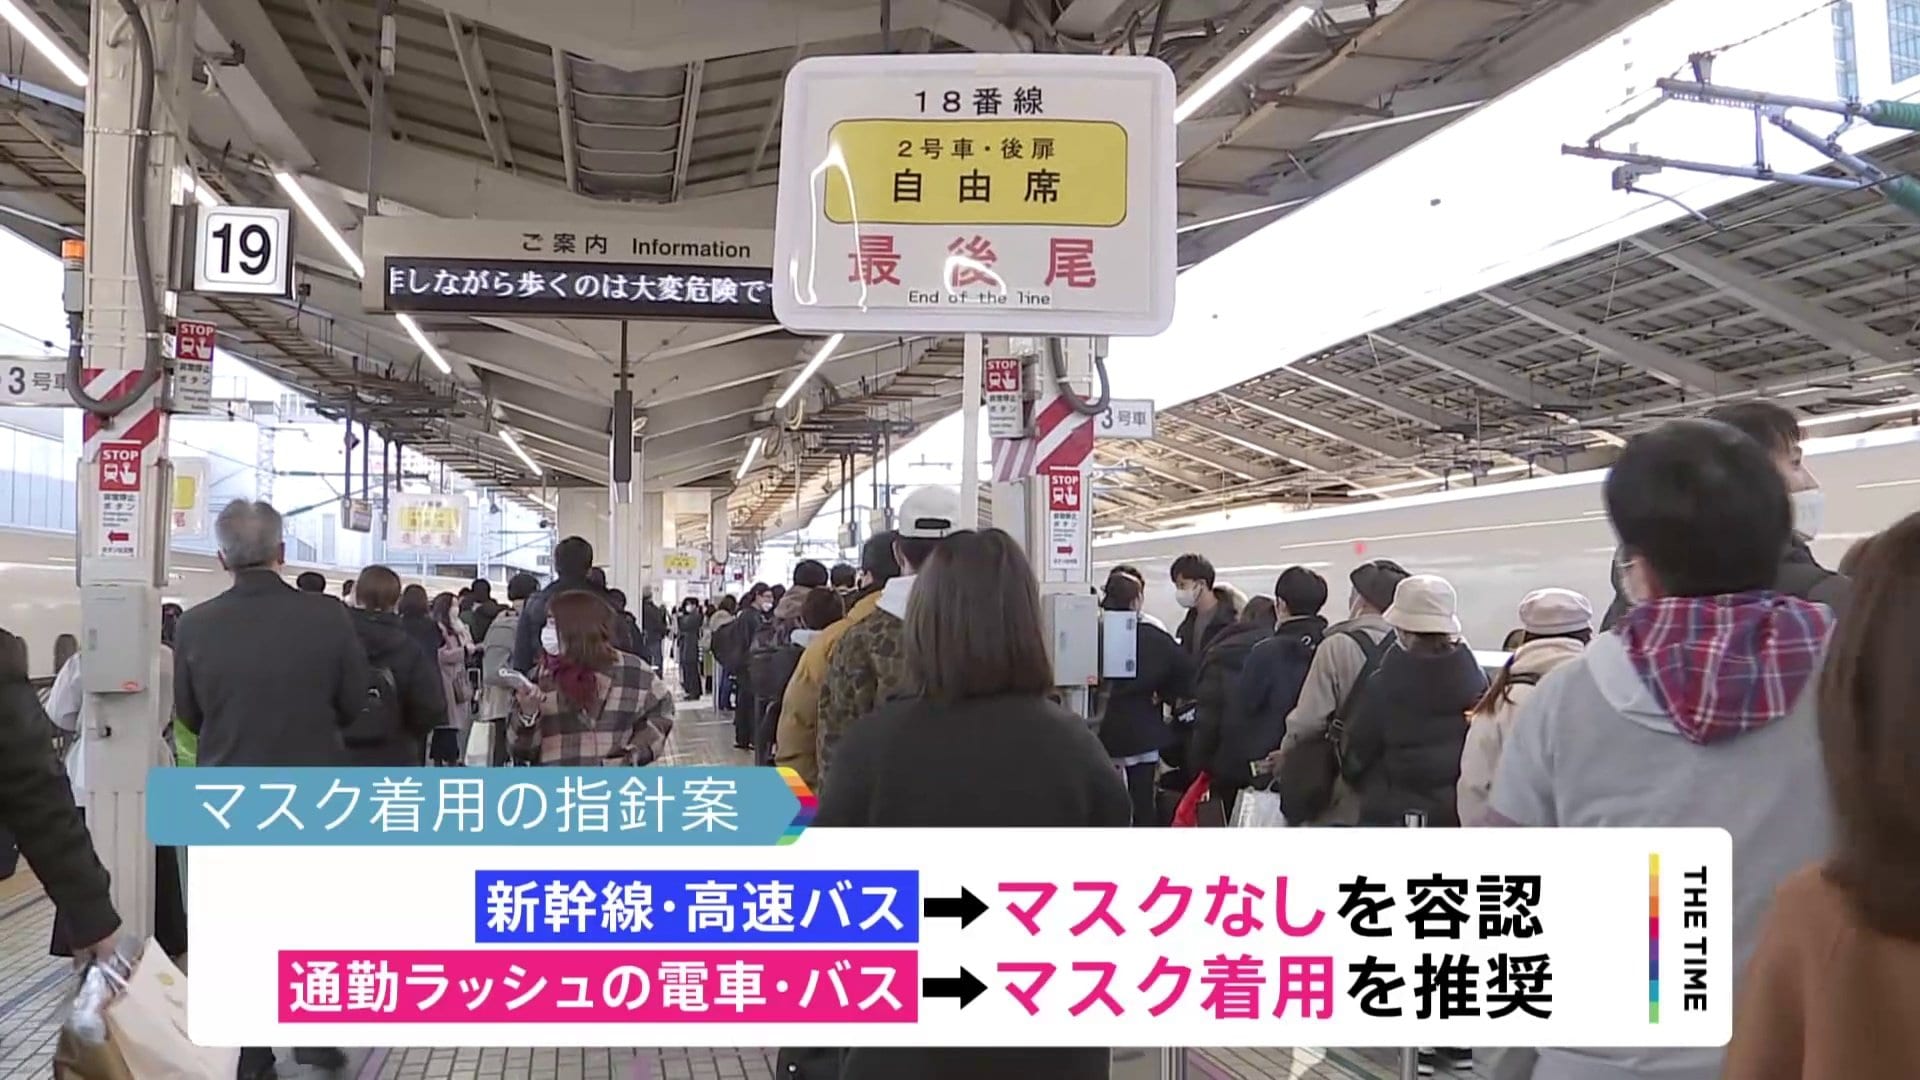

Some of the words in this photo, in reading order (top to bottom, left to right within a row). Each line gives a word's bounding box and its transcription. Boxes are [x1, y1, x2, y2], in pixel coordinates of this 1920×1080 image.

[914, 85, 1044, 116] 18番線
[897, 136, 1056, 161] 2号車・後扉
[893, 168, 1061, 204] 自由席
[212, 223, 271, 275] 19
[521, 231, 608, 255] ご案内
[632, 237, 751, 258] Information
[848, 234, 1097, 288] 最後尾
[389, 266, 772, 304] しながら歩くのは大変危険で
[908, 290, 939, 304] End
[948, 291, 968, 304] of
[979, 290, 1007, 304] the
[1017, 291, 1050, 305] line
[180, 323, 214, 337] STOP
[988, 360, 1017, 370] STOP
[1101, 406, 1146, 430] 3号車
[102, 449, 139, 461] STOP
[1051, 475, 1079, 485] STOP
